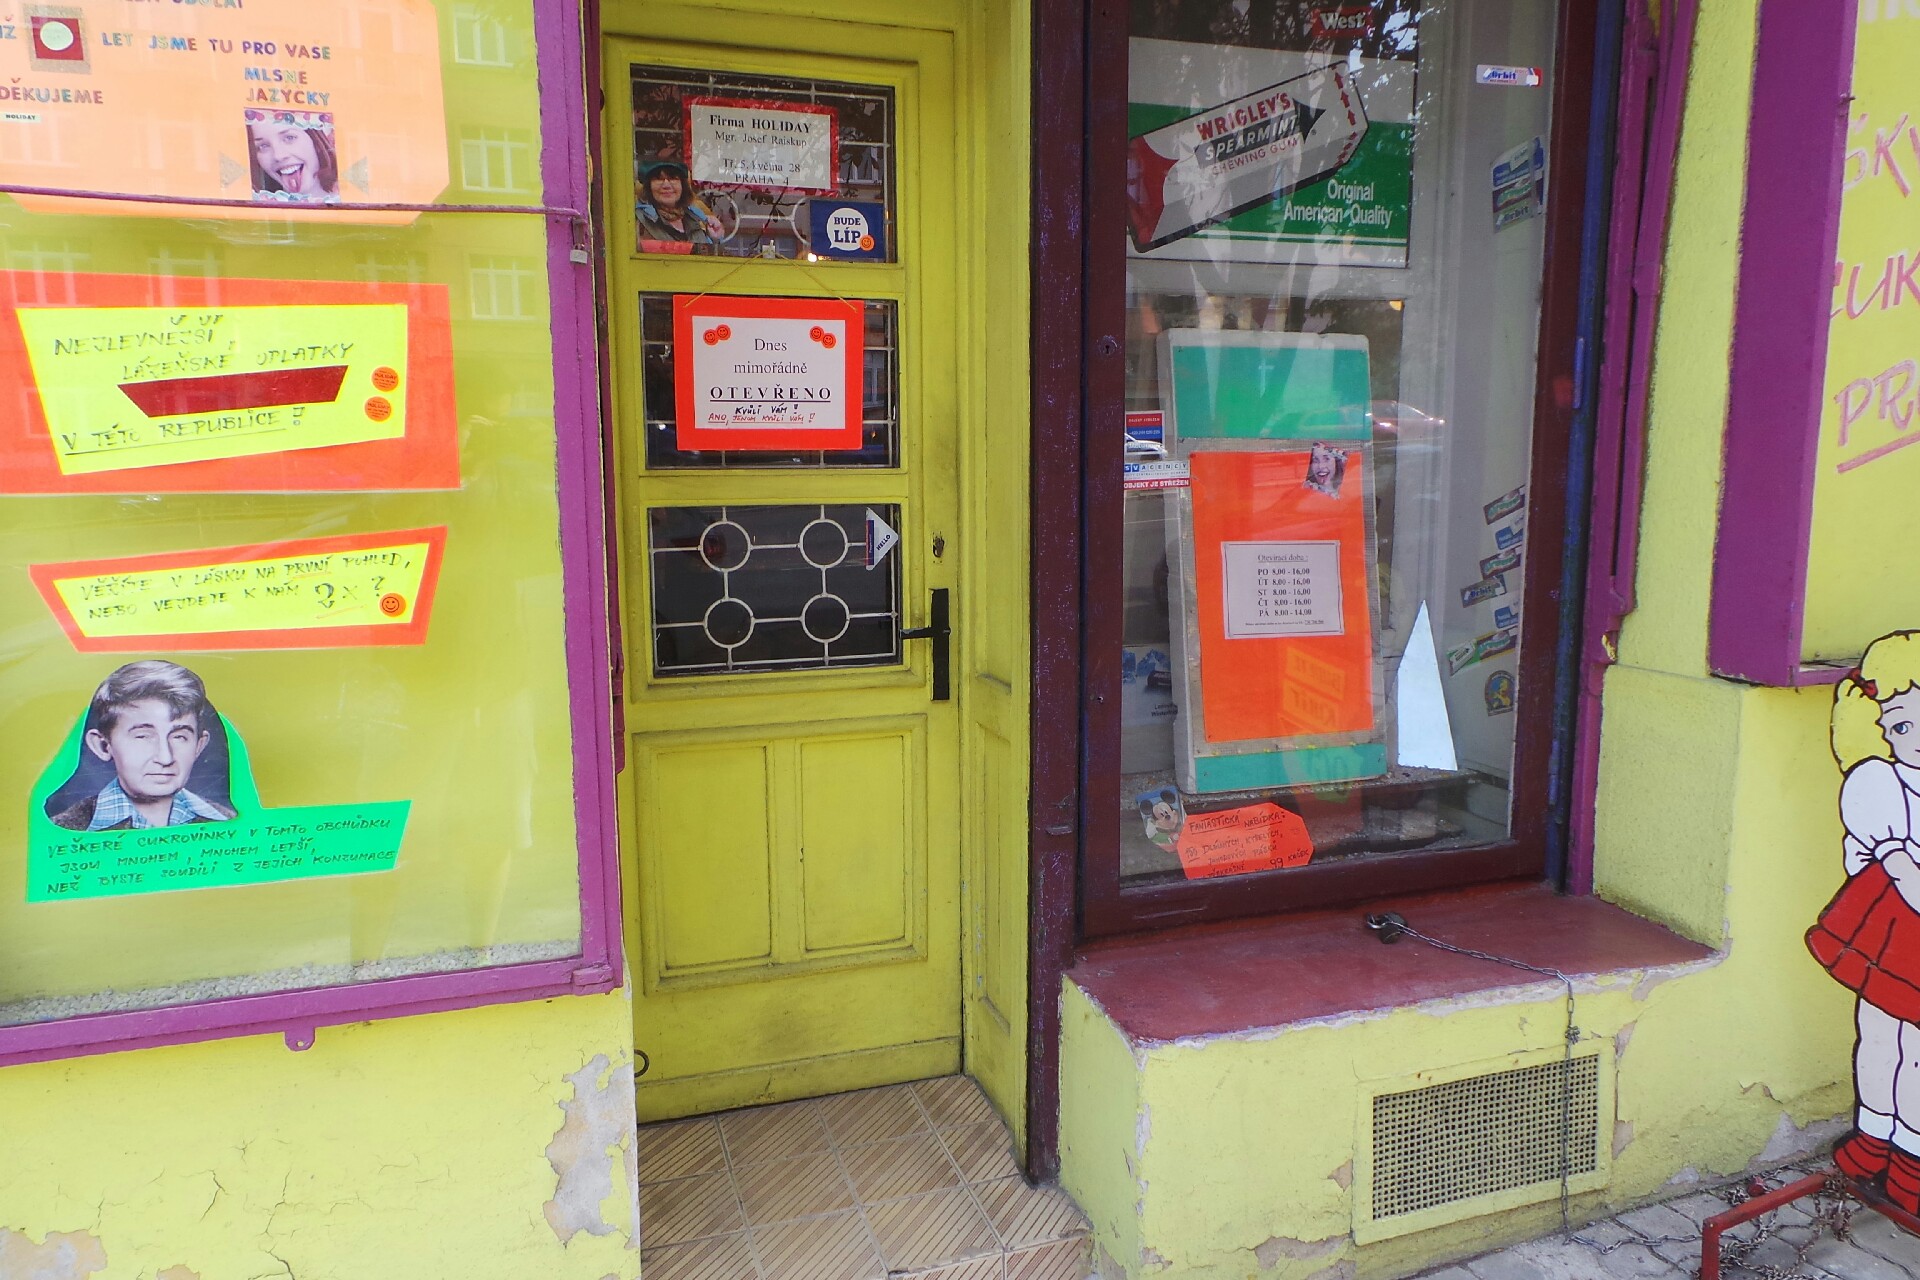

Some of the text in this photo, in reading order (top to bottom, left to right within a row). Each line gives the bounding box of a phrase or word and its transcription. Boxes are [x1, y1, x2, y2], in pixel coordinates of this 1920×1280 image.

[1319, 12, 1366, 30] West
[101, 31, 133, 47] LET
[149, 33, 198, 51] JSME
[208, 38, 233, 54] TU
[242, 41, 277, 56] PRO
[1492, 70, 1516, 79] Orbit
[709, 114, 811, 134] Firma HOLIDAY
[1196, 92, 1291, 141] WRIGLEY'S
[715, 130, 807, 149] Mgr. Josef Raiskup
[1205, 114, 1299, 161] SPEARMINT
[740, 160, 749, 170] 5.
[788, 163, 800, 173] 28
[1212, 148, 1266, 176] CHEWING
[735, 173, 790, 186] PRAHA 4
[1327, 179, 1375, 204] Original
[833, 216, 861, 226] BUDE
[1284, 201, 1393, 229] American Quality
[833, 227, 861, 243] LÍP
[54, 314, 224, 356] NEJLEVNĚJŠÍ
[754, 338, 788, 351] Dnes
[257, 342, 354, 366] OPLATKY
[733, 361, 808, 375] mimořádně
[709, 384, 832, 400] OTEVŘENO
[735, 404, 761, 415] KVŮLI
[771, 402, 788, 414] VÁM
[1833, 359, 1920, 447] PR
[708, 412, 729, 426] ANO,
[62, 432, 77, 450] V
[91, 423, 140, 447] TÉTO
[158, 408, 280, 439] REPUBLICE
[1124, 481, 1149, 489] OBJEKT
[1160, 479, 1189, 487] STŘEŽEN
[876, 534, 891, 551] HELLO
[171, 575, 182, 588] V
[194, 568, 246, 586] LÁSKU
[256, 565, 276, 579] NA
[284, 554, 335, 577] PRVNÍ
[1257, 568, 1269, 576] PO
[89, 603, 138, 620] NEBO
[244, 587, 256, 599] K
[371, 575, 386, 598] ?
[1258, 598, 1269, 607] ČT
[1259, 608, 1270, 617] PÁ
[1189, 810, 1286, 831] FANTASTICKÁ NABÍDKA:
[47, 832, 127, 859] VEŠKERÉ
[137, 826, 237, 848] CUKROVINKY
[265, 824, 307, 837] TOMTO
[315, 814, 391, 832] OBCHŮDKU
[60, 860, 100, 874] JSOU
[200, 846, 259, 859] MNOHEM
[47, 874, 81, 894] NEŽ
[97, 872, 144, 887] BYSTE
[161, 860, 218, 878] SOUDILI
[253, 854, 303, 870] JEJICH
[312, 849, 396, 865] KONZUMACE
